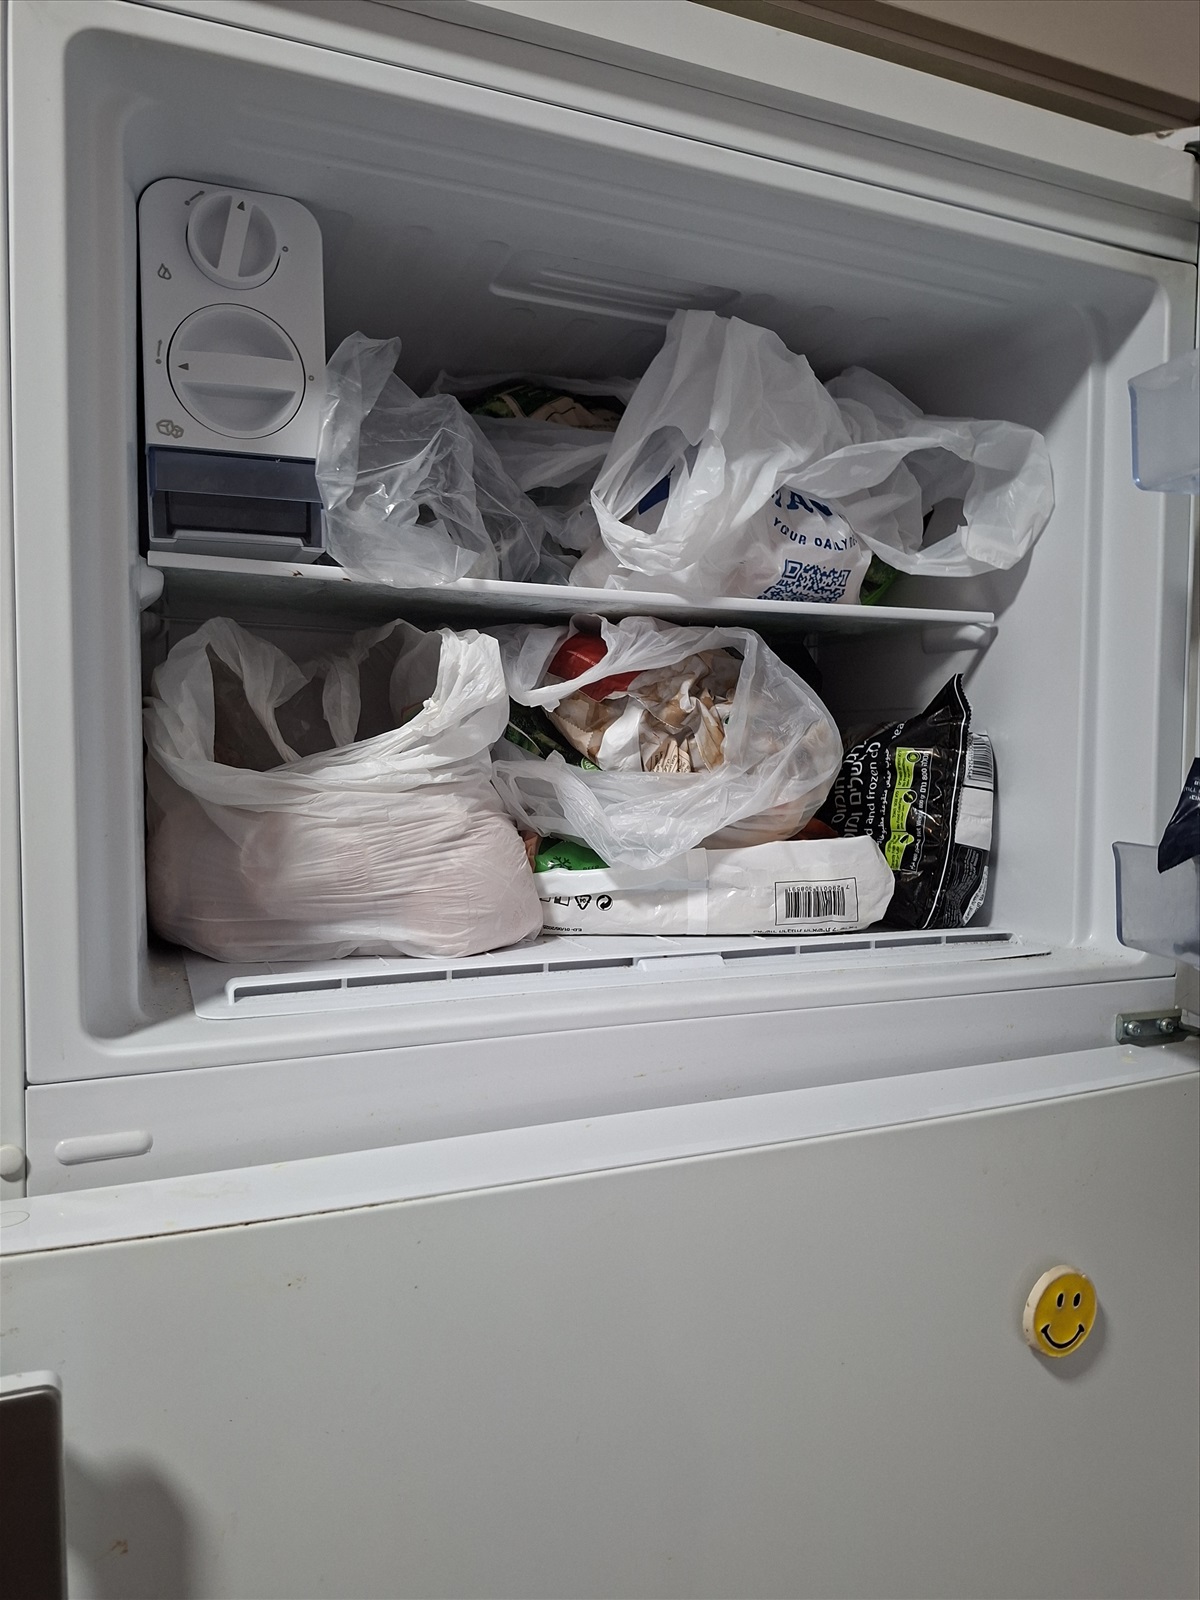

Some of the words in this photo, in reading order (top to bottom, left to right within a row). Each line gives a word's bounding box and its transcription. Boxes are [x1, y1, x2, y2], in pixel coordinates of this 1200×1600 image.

[773, 517, 807, 545] YOUR
[866, 761, 879, 800] frozen
[920, 767, 929, 781] 800
[865, 803, 876, 825] and
